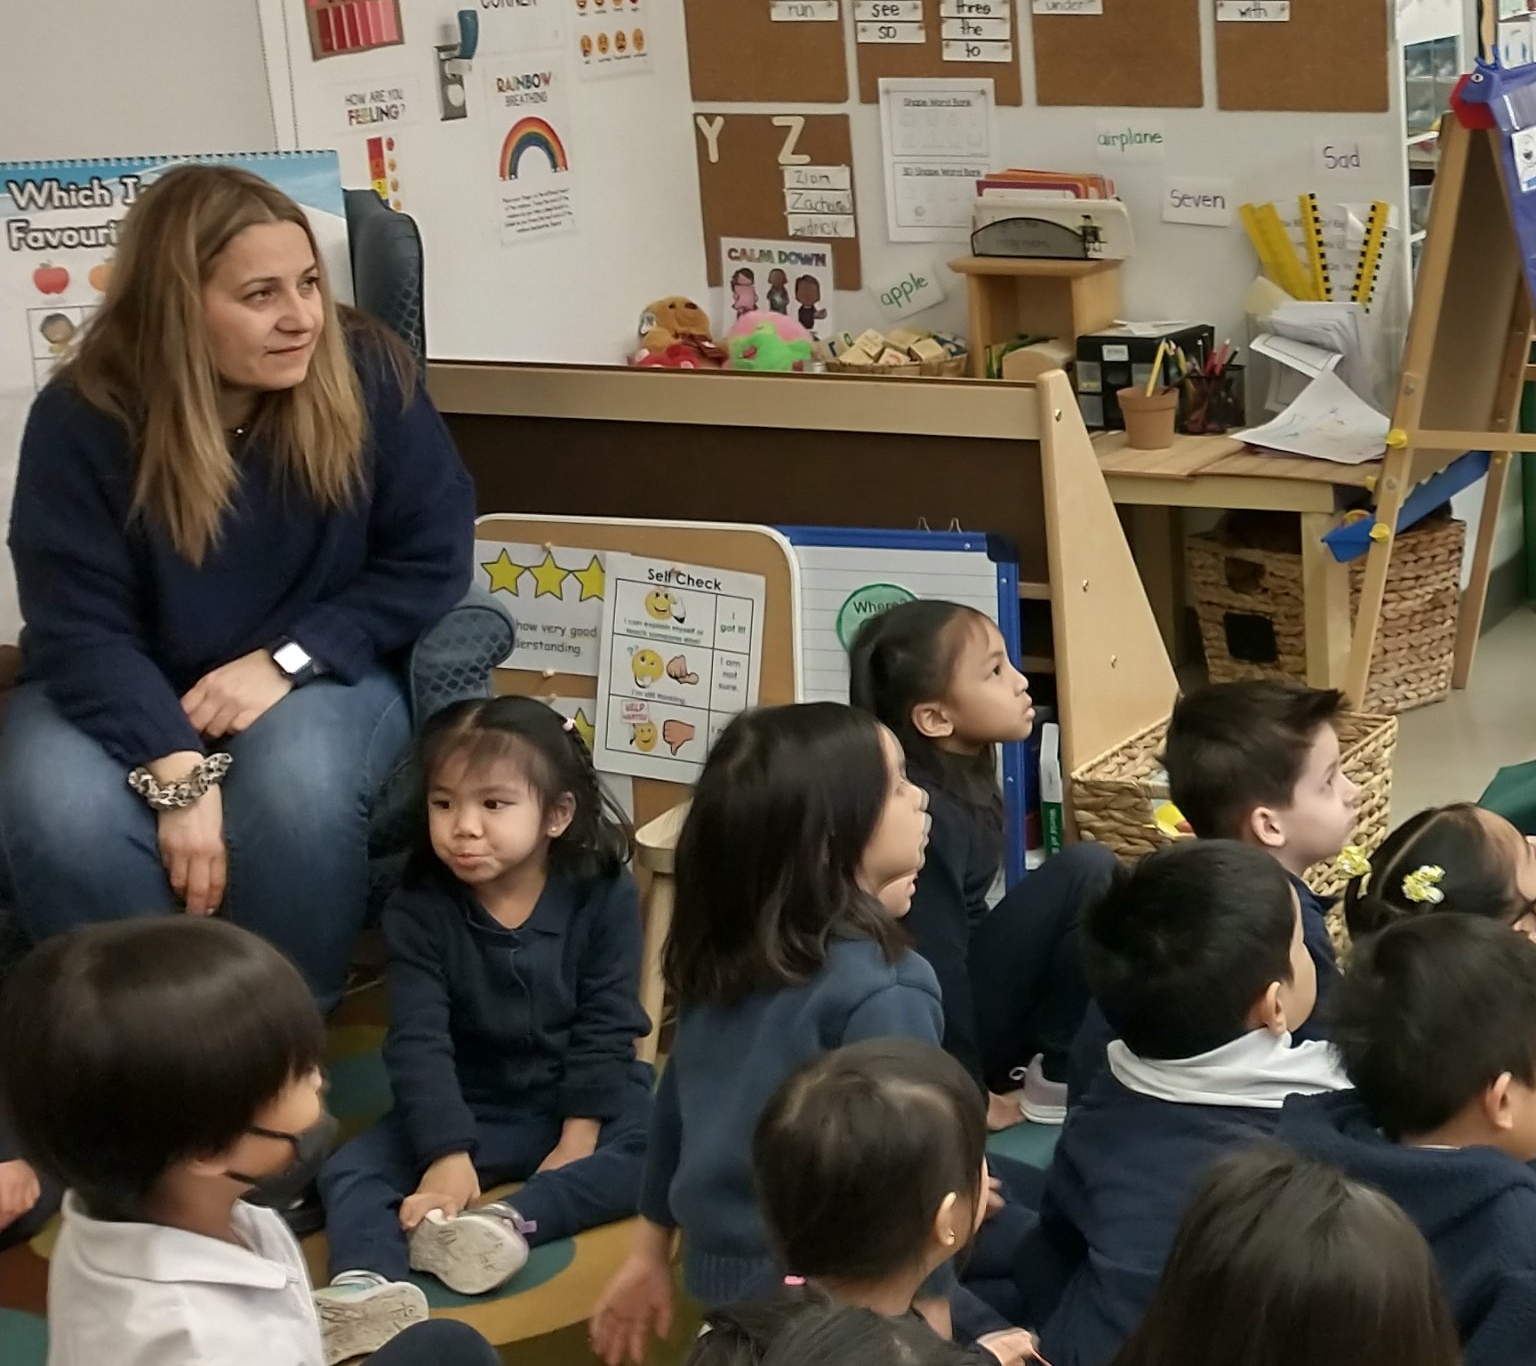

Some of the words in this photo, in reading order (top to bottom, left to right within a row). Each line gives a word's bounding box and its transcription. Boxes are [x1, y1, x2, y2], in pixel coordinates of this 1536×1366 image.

[871, 3, 901, 17] see
[496, 72, 552, 93] RAINBOW
[696, 115, 724, 163] Y
[772, 115, 811, 165] Z
[1097, 128, 1163, 152] airplane
[1322, 143, 1361, 170] Sad
[6, 176, 112, 210] Which
[119, 174, 148, 205] I
[1169, 189, 1226, 211] Seven
[727, 246, 774, 265] CALM
[778, 250, 827, 267] DOWN
[880, 272, 929, 308] apple
[648, 568, 673, 584] Self
[676, 572, 722, 592] Check
[541, 622, 567, 638] very
[569, 623, 599, 639] good
